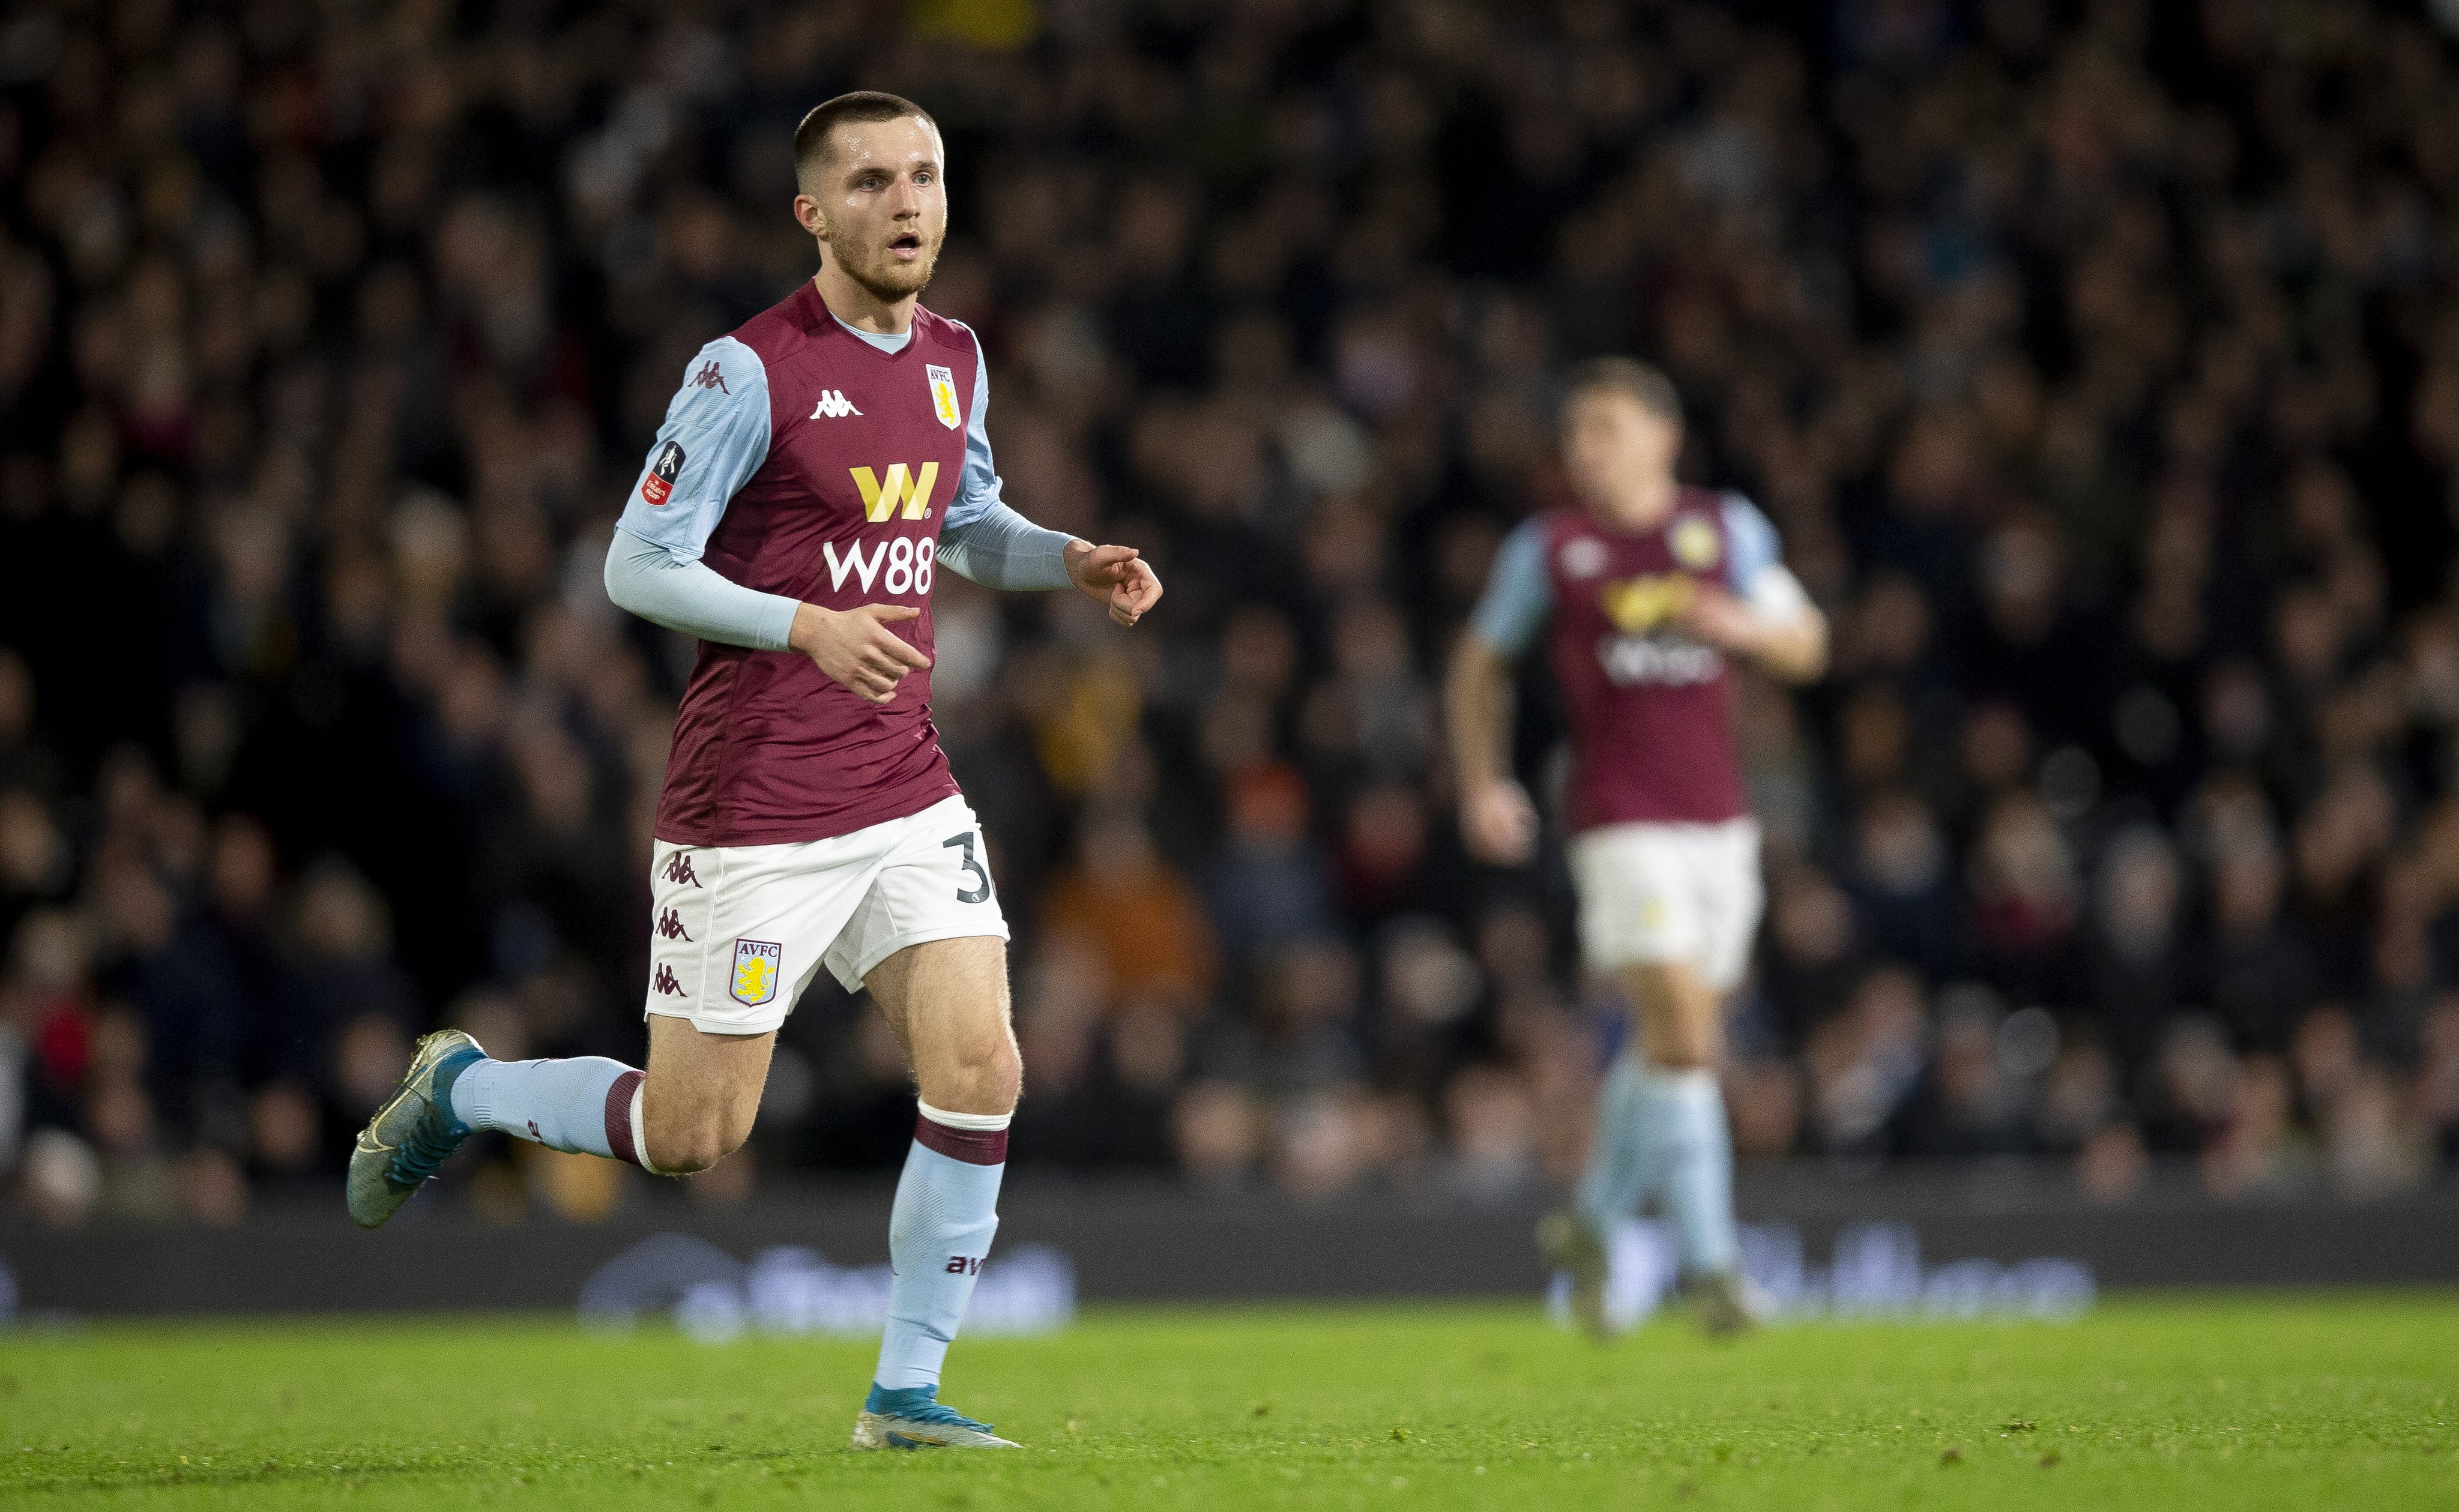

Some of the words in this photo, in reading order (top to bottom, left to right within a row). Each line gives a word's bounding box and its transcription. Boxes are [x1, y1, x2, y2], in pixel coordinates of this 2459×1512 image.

[931, 369, 950, 382] AVFC
[822, 536, 935, 595] W88
[738, 942, 778, 958] AVFC
